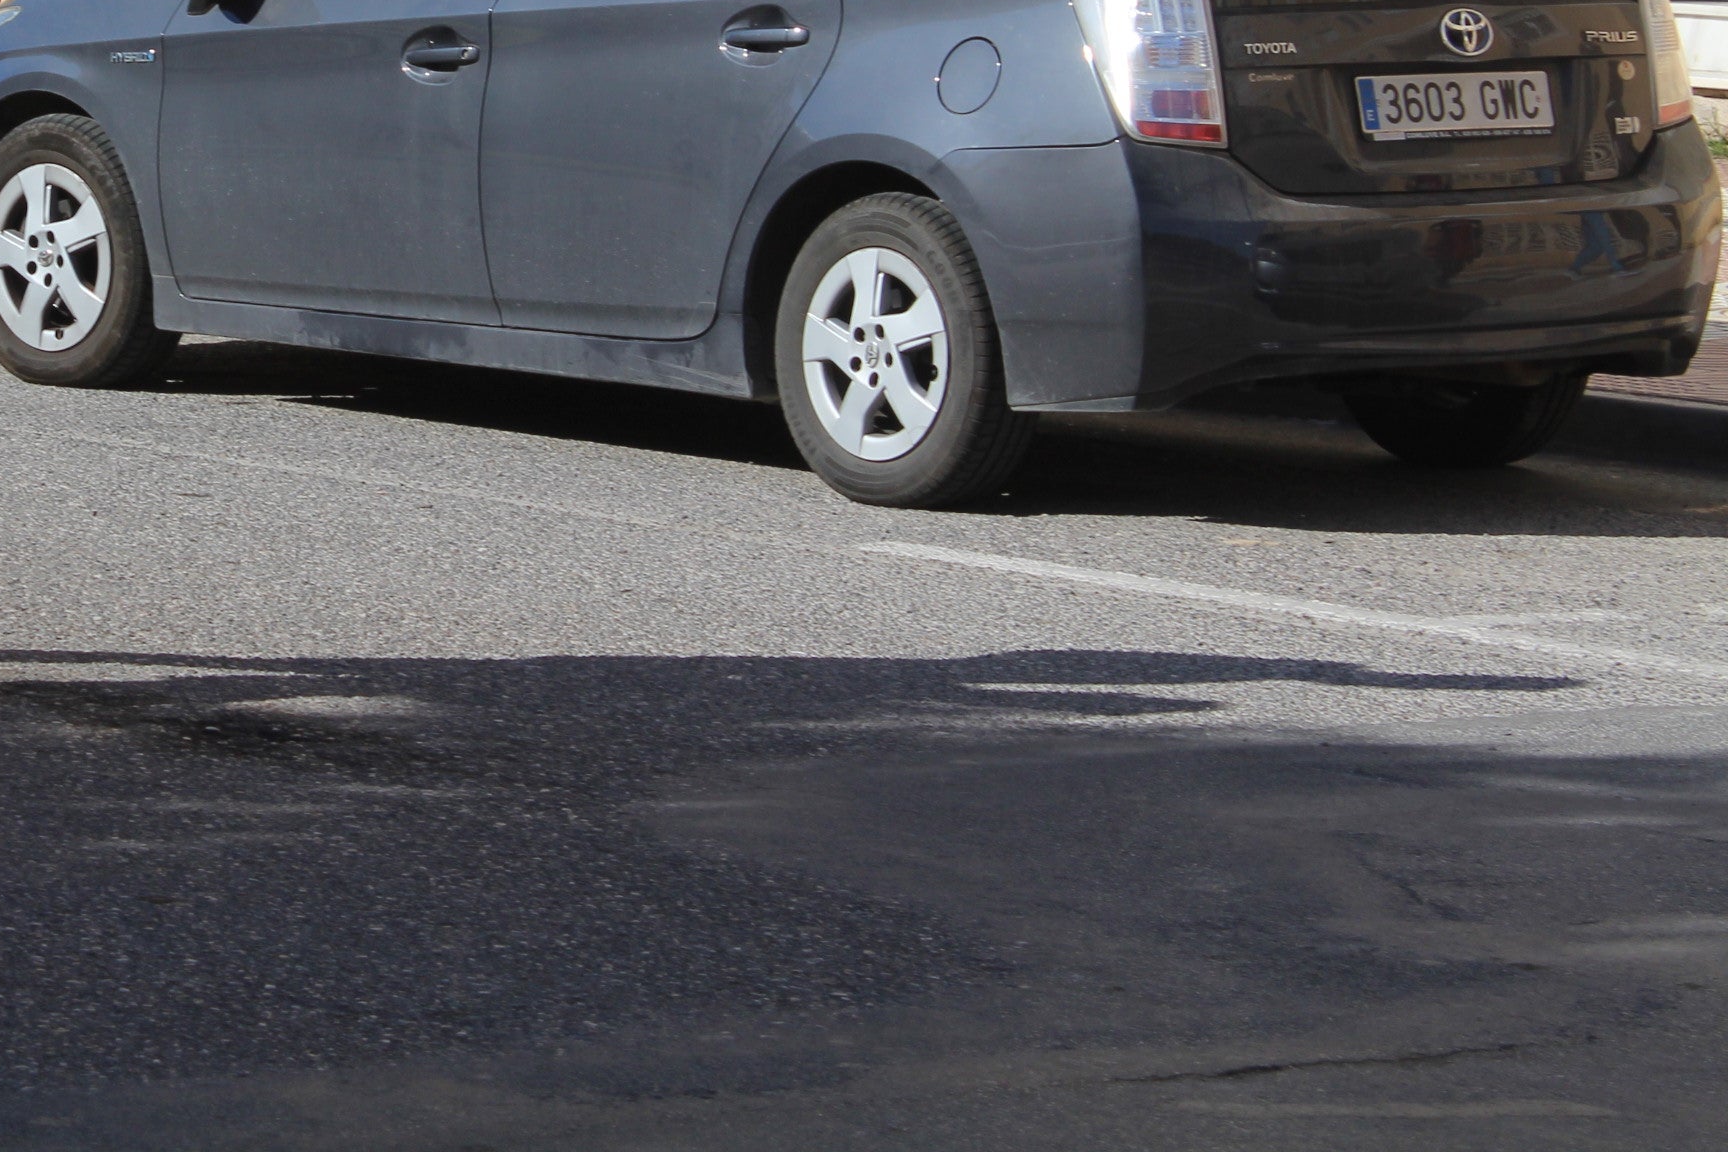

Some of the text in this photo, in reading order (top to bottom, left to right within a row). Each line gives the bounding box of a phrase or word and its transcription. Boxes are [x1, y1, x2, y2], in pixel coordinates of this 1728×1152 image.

[1585, 30, 1638, 42] PRIUS
[1244, 42, 1298, 55] TOYOTA
[1382, 81, 1466, 125] 3603
[1479, 79, 1539, 121] GWC
